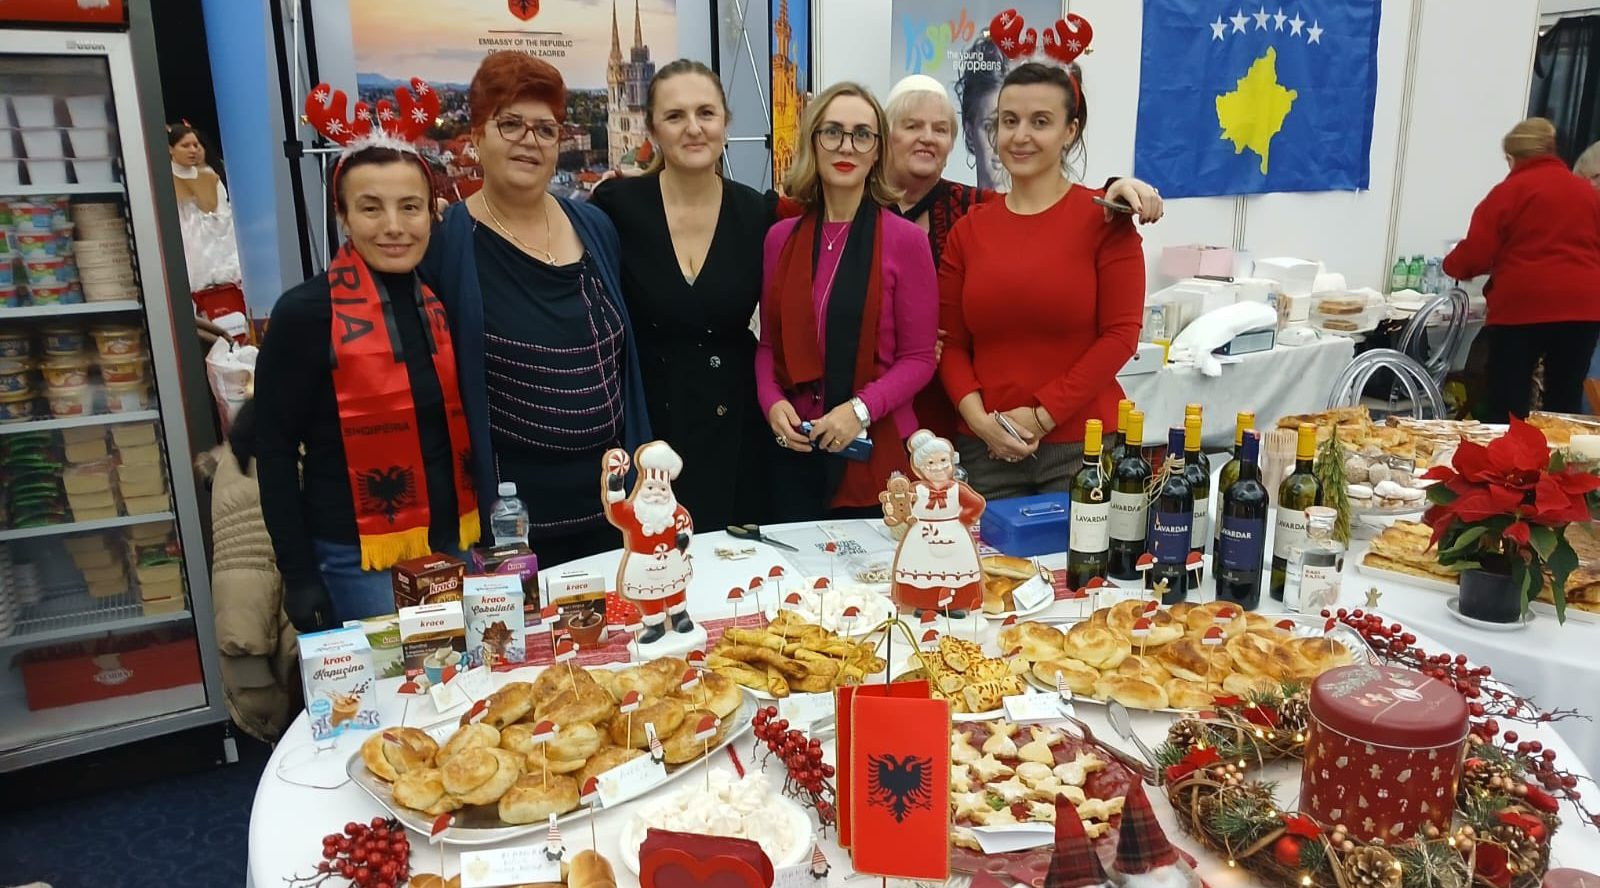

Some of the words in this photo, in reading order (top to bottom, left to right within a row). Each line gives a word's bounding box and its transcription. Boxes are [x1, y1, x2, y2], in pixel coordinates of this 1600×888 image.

[478, 38, 512, 46] EMBASSY
[526, 39, 538, 47] THE
[539, 40, 573, 48] REPUBLIC
[538, 49, 566, 57] ZAGREB
[947, 50, 959, 60] the
[959, 51, 984, 61] young
[952, 59, 1001, 74] europeans
[429, 578, 458, 595] kraco
[566, 582, 588, 591] kraco
[481, 595, 506, 604] kraco
[420, 619, 445, 628] kraco
[323, 654, 352, 667] kraco
